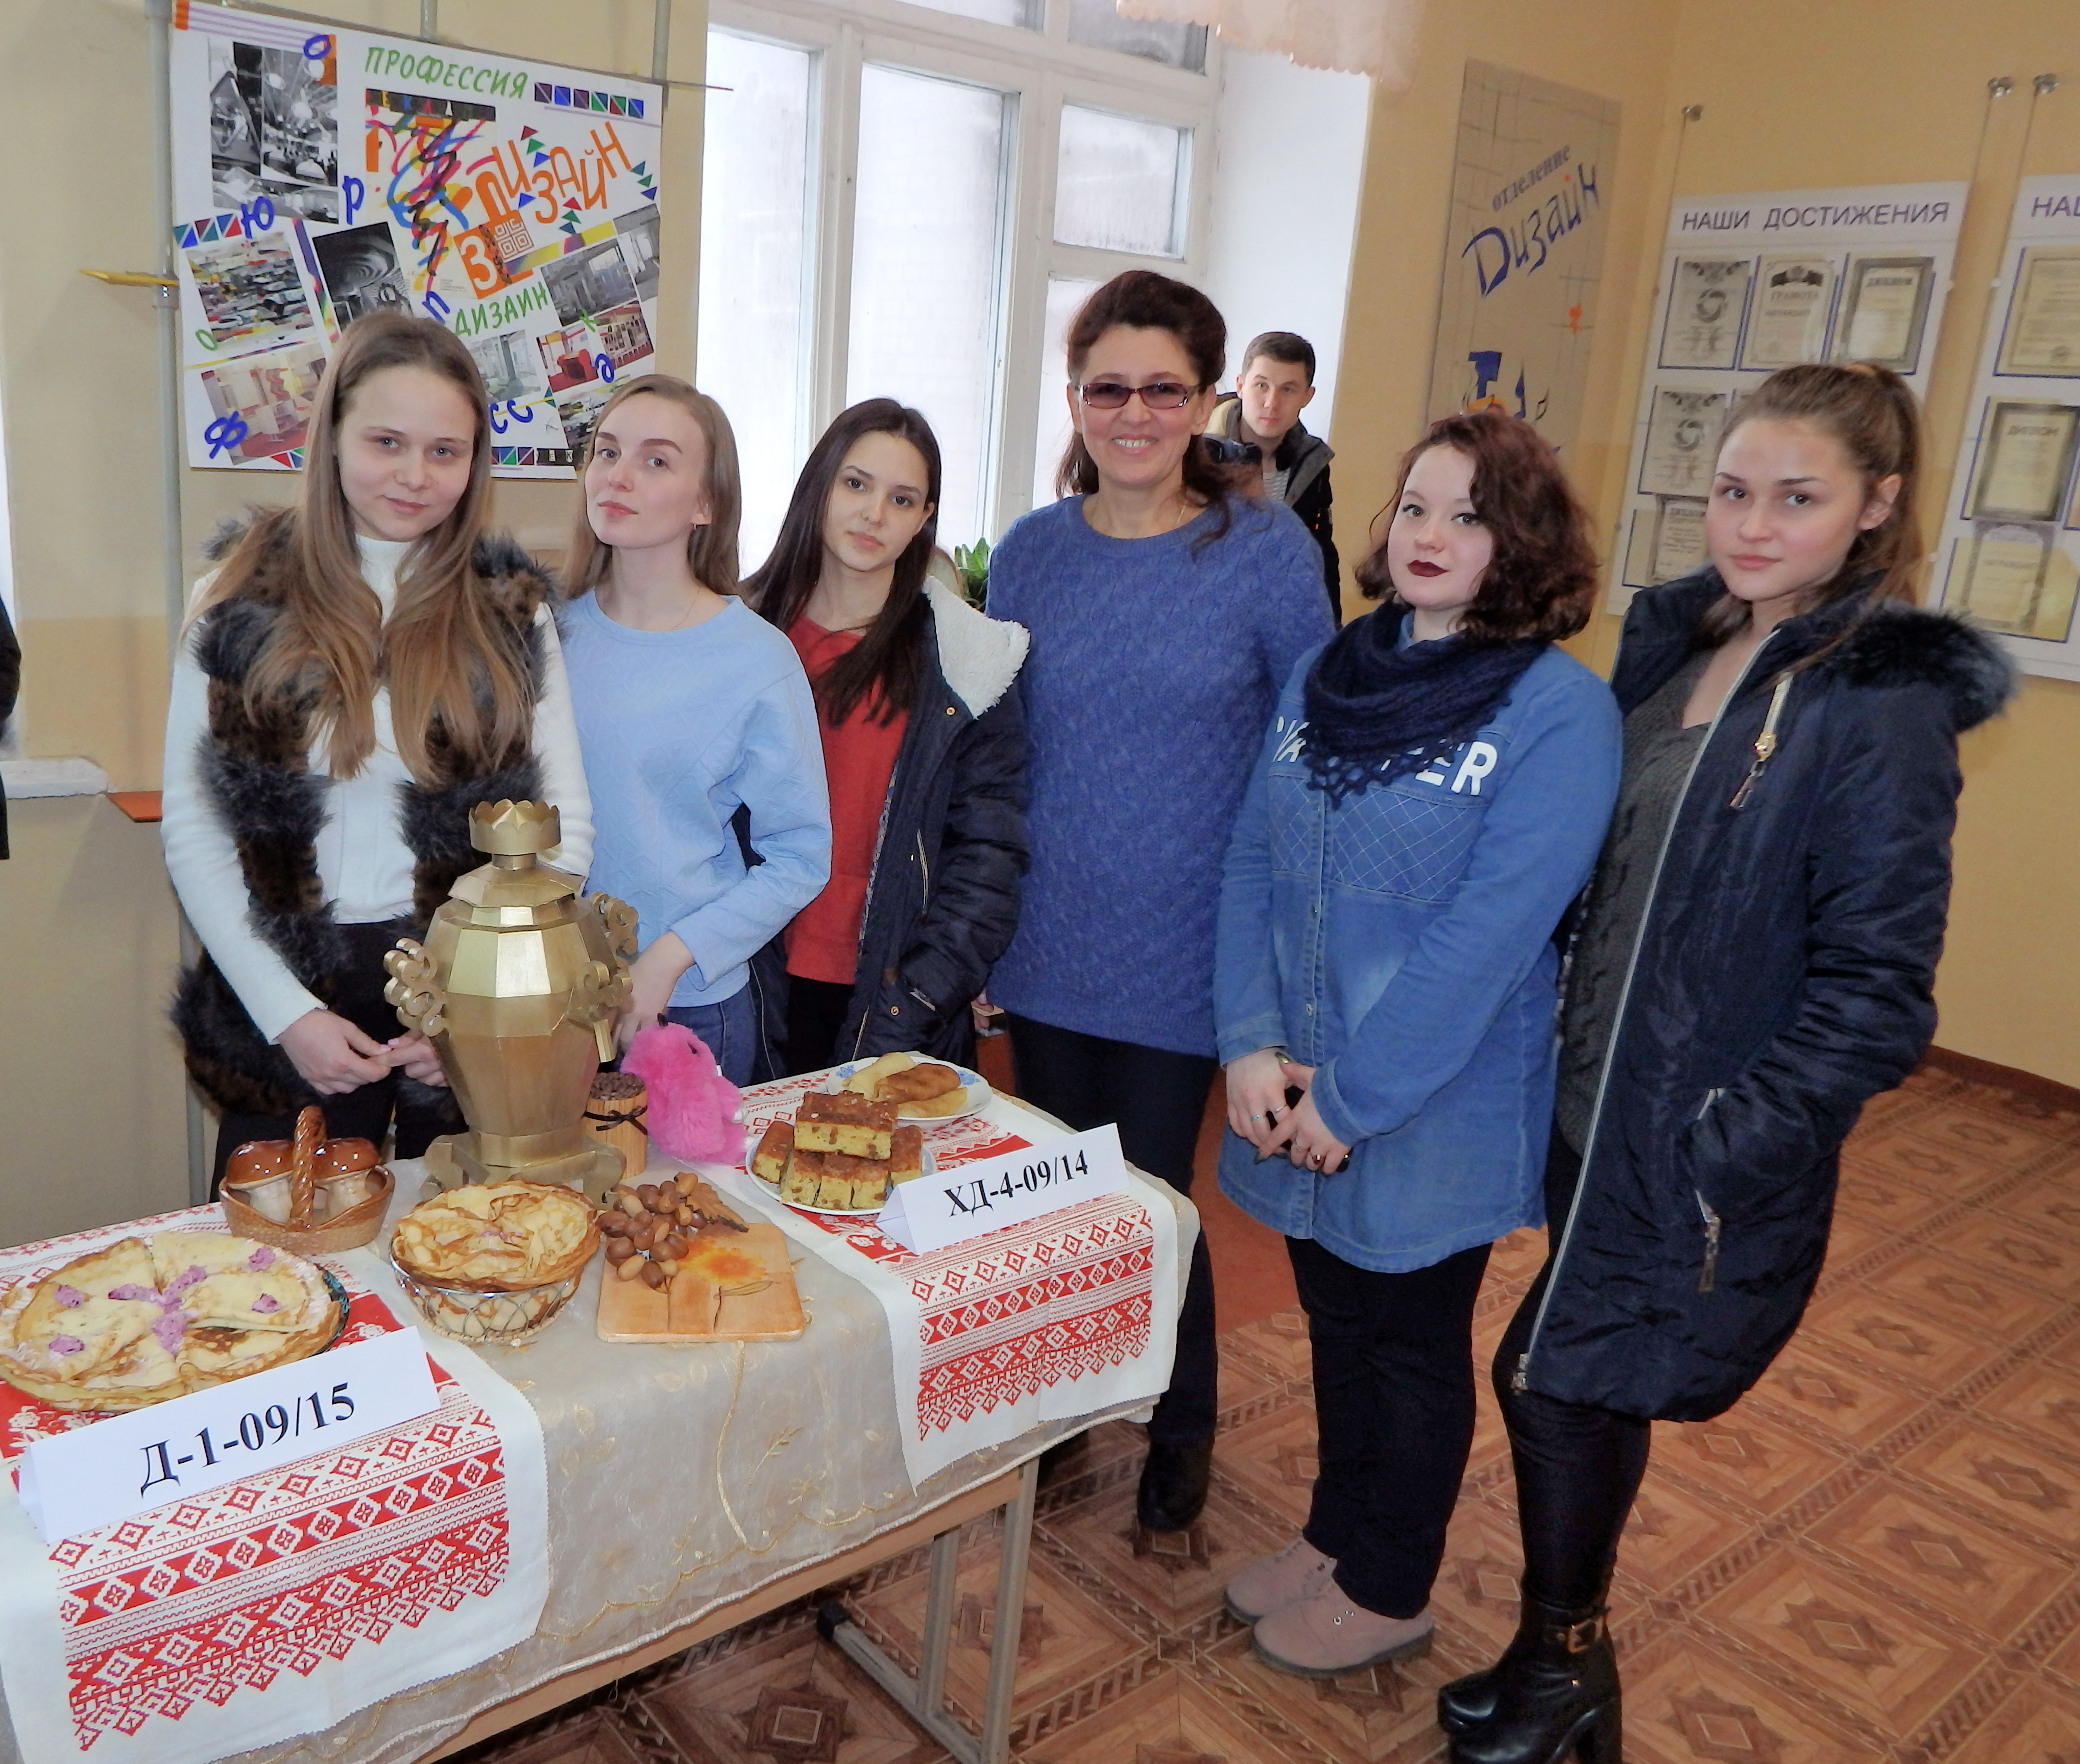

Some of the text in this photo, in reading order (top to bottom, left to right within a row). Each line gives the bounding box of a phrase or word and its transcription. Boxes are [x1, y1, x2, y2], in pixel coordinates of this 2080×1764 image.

[365, 46, 528, 99] ПРОФЕССИЯ
[1681, 202, 1950, 232] НАШИ ДОСТИЖЕНИЯ
[942, 1149, 1089, 1218] ХД-4-09/14
[140, 1382, 355, 1499] Д-1-09/15
